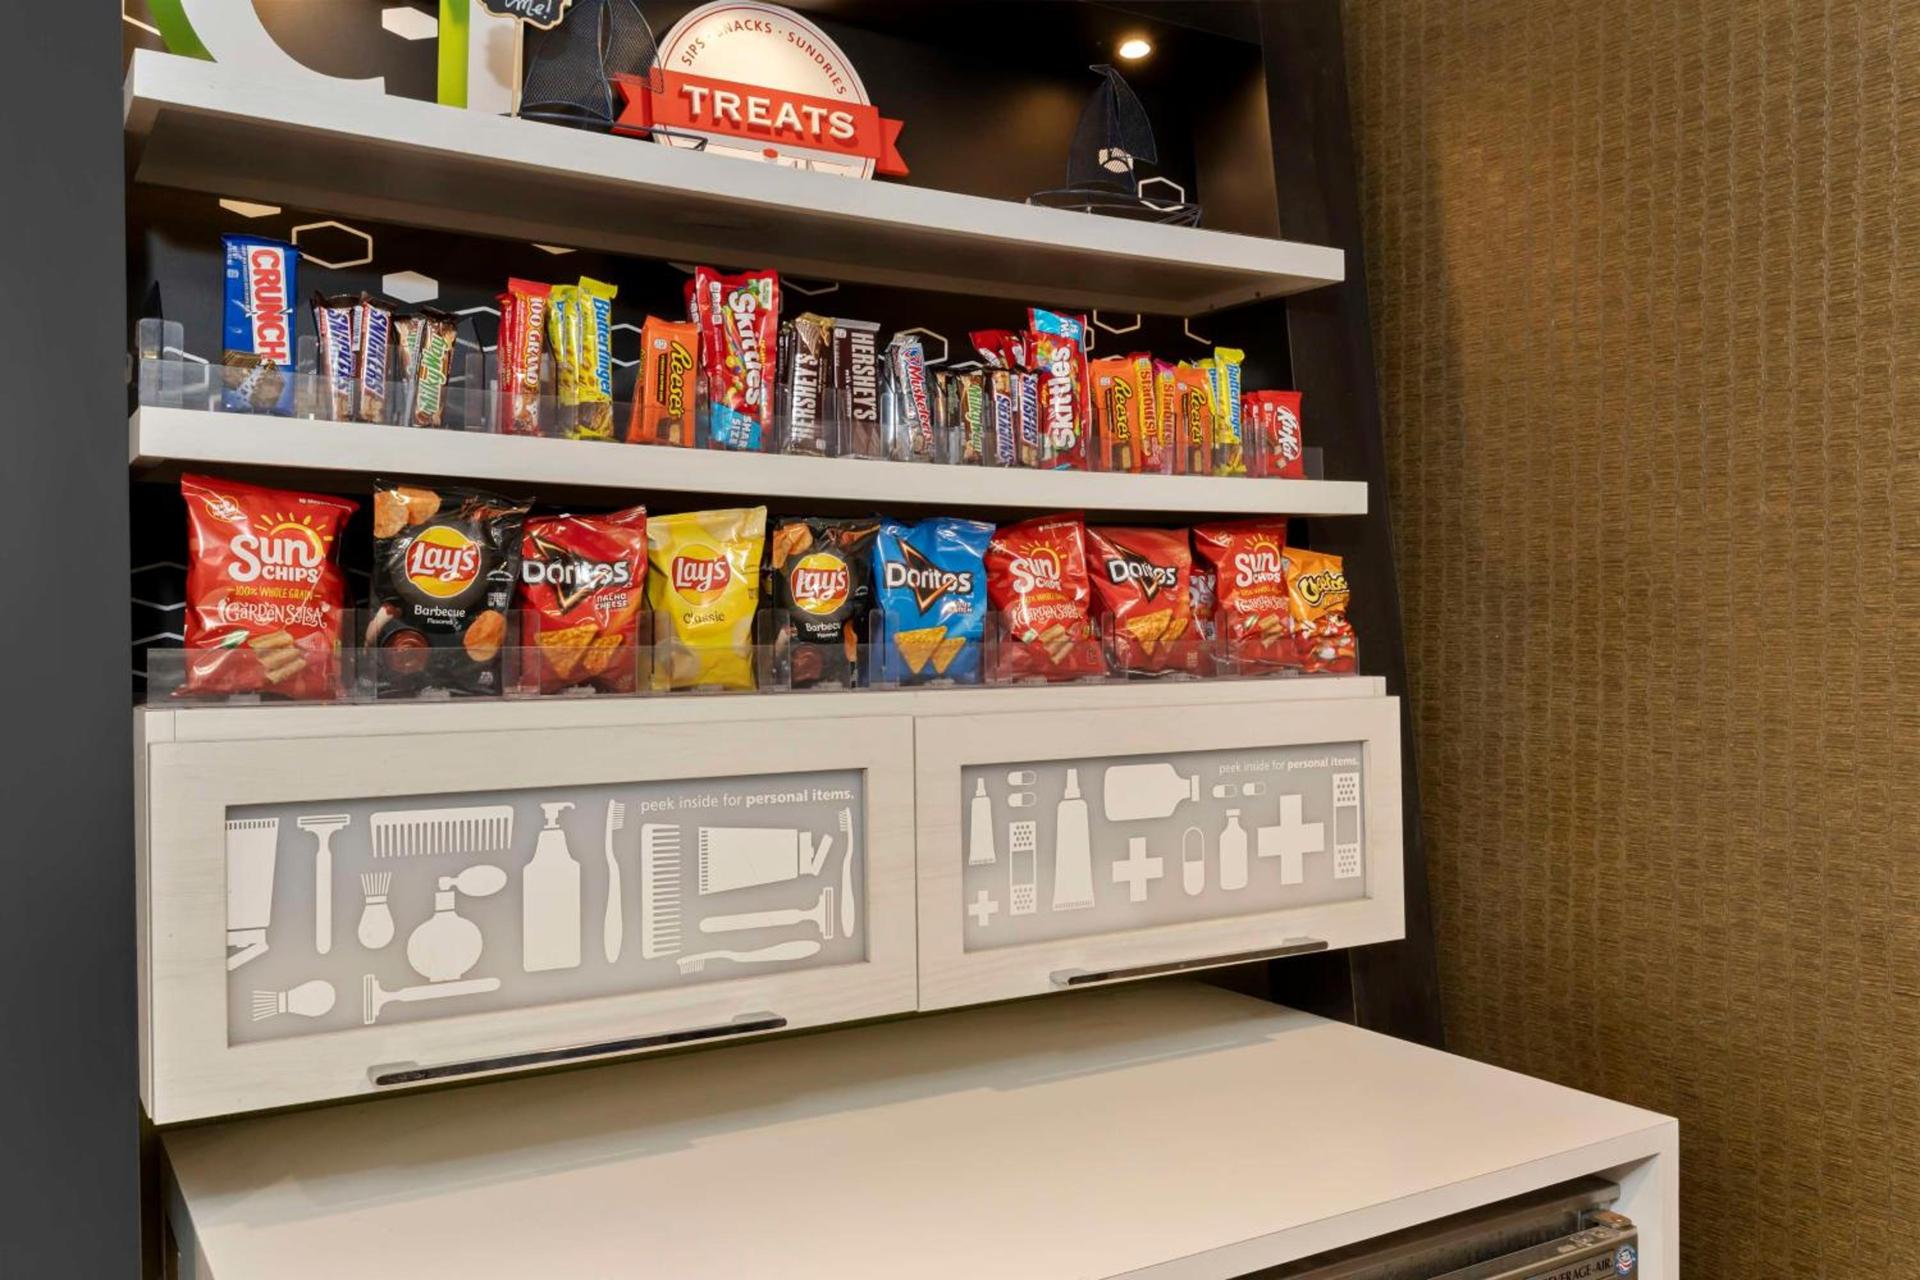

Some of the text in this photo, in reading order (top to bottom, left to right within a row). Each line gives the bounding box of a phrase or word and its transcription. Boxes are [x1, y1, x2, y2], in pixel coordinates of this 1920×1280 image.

[681, 19, 847, 95] SIPS NACKS SUNDRIES
[680, 83, 856, 141] TREATS
[251, 249, 286, 362] CRUNCH
[364, 308, 389, 396] SNICKERS
[524, 297, 546, 386] 100 GRAND
[592, 297, 612, 397] Butterfinger
[727, 291, 761, 406] Skittles
[667, 340, 693, 418] Reese's
[792, 353, 819, 441] HERSHEY'S
[851, 331, 877, 422] HERSHEY'S
[1048, 347, 1076, 449] Skittles
[1226, 364, 1241, 438] Butterfinger
[1113, 376, 1134, 441] Reese's
[1188, 386, 1207, 444] Reese's
[228, 534, 325, 582] Sun
[262, 565, 320, 584] CHIPS
[411, 541, 478, 582] Lay's
[522, 559, 630, 586] Doritos
[676, 556, 727, 593] Lay's
[796, 568, 847, 601] Lay's
[886, 562, 972, 594] Doritos
[1009, 557, 1061, 594] Sun
[1108, 559, 1177, 586] Doritos
[1235, 552, 1281, 588] Sun
[414, 604, 466, 619] Barbecue
[1218, 756, 1361, 776] peek inside for personal items.
[641, 788, 855, 815] peek inside for personal items.
